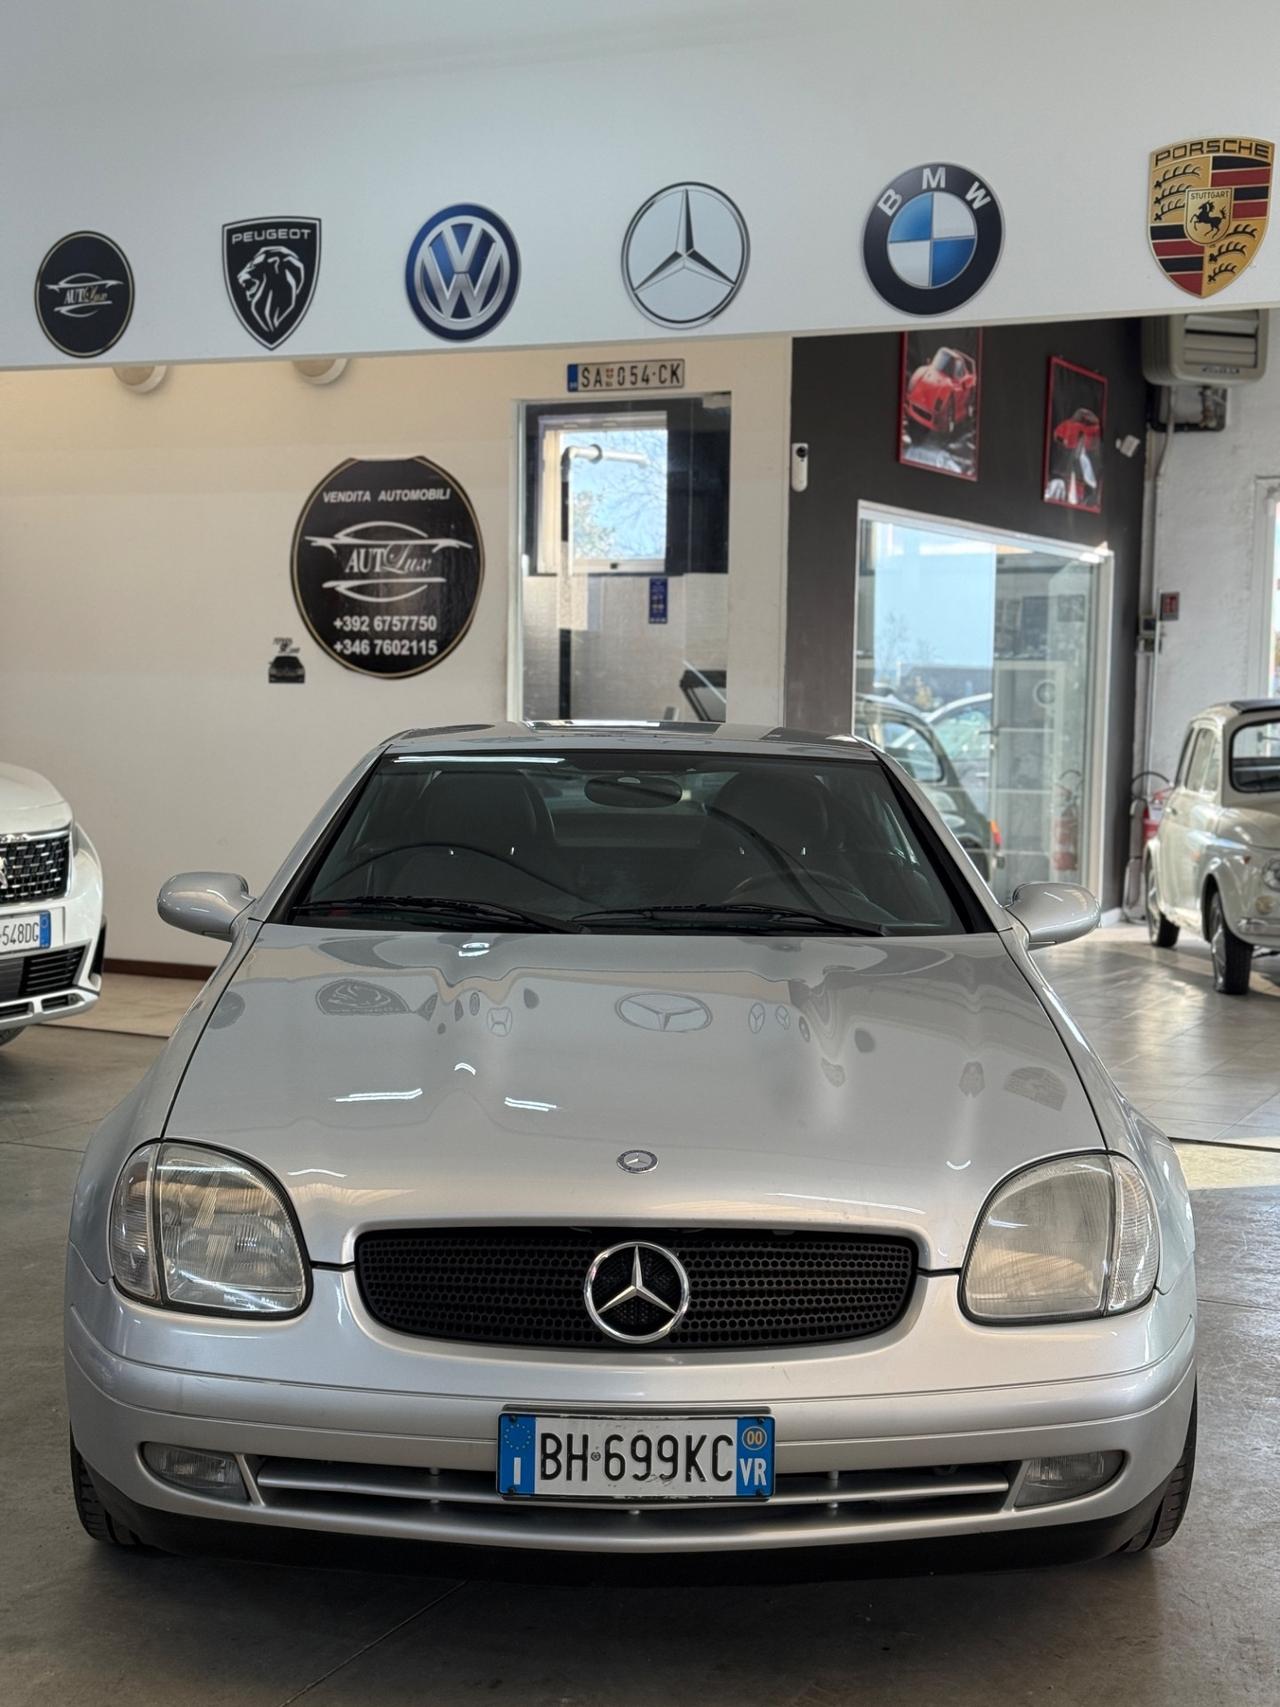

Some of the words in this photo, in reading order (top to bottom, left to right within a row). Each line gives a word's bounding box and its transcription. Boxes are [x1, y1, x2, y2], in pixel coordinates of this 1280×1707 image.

[1155, 139, 1270, 166] PORSCHE
[877, 166, 992, 217] BMW
[1190, 190, 1230, 201] STUTTGART
[231, 228, 311, 244] PEUGEOT
[581, 367, 602, 388] SA
[322, 490, 371, 503] VENDITA
[378, 488, 451, 501] AUTOMOBILI
[333, 615, 370, 631] +392
[373, 615, 437, 631] 6757750
[333, 639, 371, 655] +346
[374, 639, 438, 655] 7602115
[739, 1458, 768, 1487] VR
